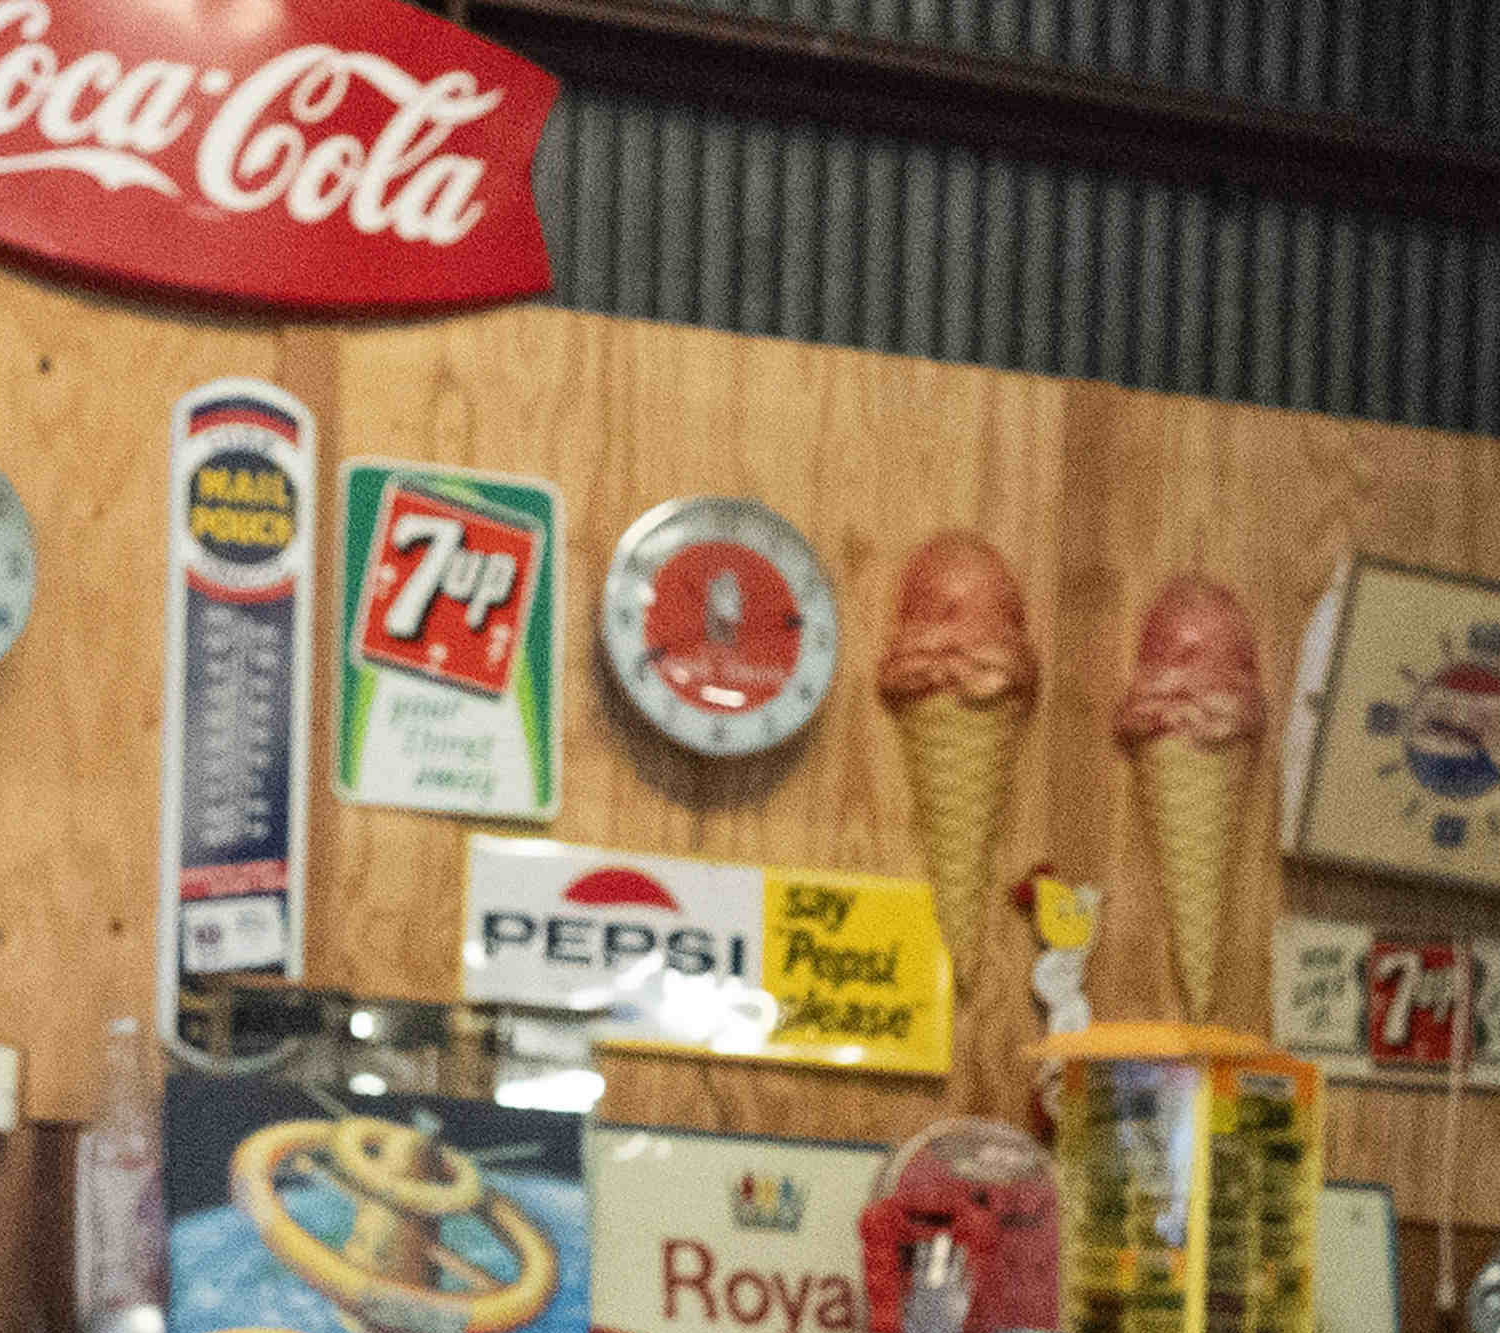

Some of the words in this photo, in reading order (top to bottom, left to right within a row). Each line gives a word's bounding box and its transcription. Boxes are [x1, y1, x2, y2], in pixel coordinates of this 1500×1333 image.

[198, 468, 288, 502] MAIL
[194, 506, 291, 550] POUCH
[784, 884, 857, 933] say
[482, 910, 746, 979] PEPSI
[782, 936, 900, 985] Pepsi
